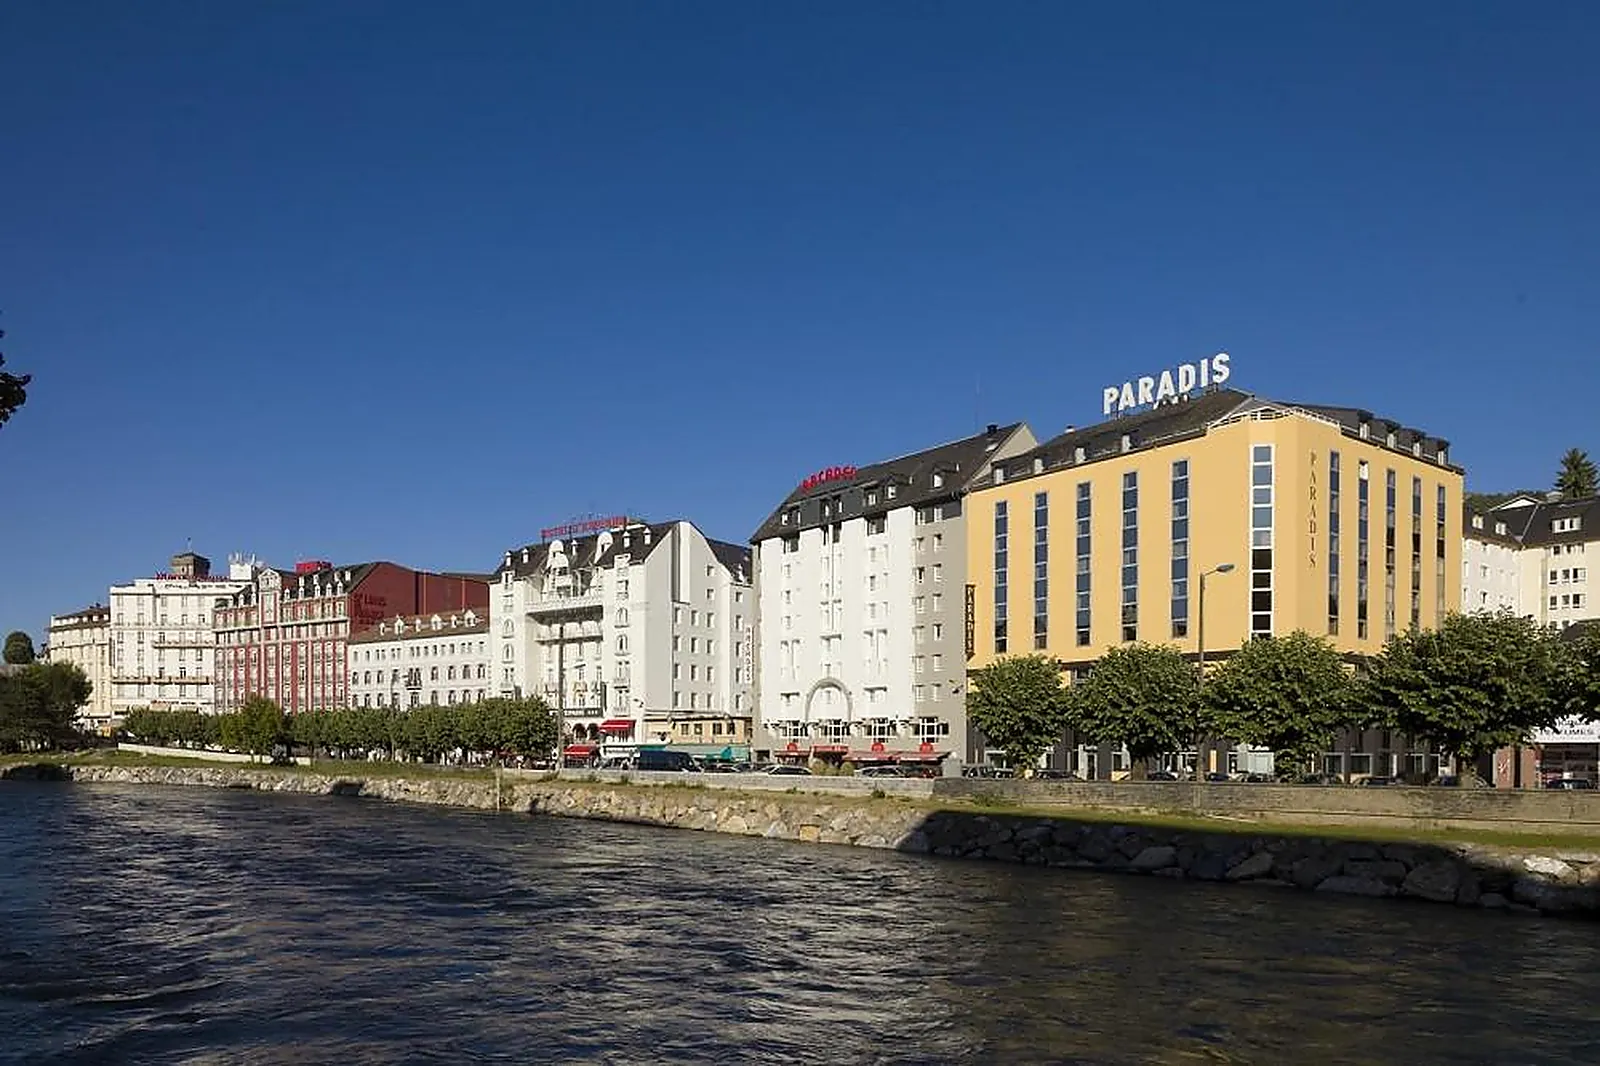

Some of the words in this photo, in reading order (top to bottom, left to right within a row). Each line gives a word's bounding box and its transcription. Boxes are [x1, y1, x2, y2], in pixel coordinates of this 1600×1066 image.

[1103, 352, 1230, 415] PARADIS
[1309, 450, 1317, 568] PARADIS
[966, 586, 974, 653] PARADIS
